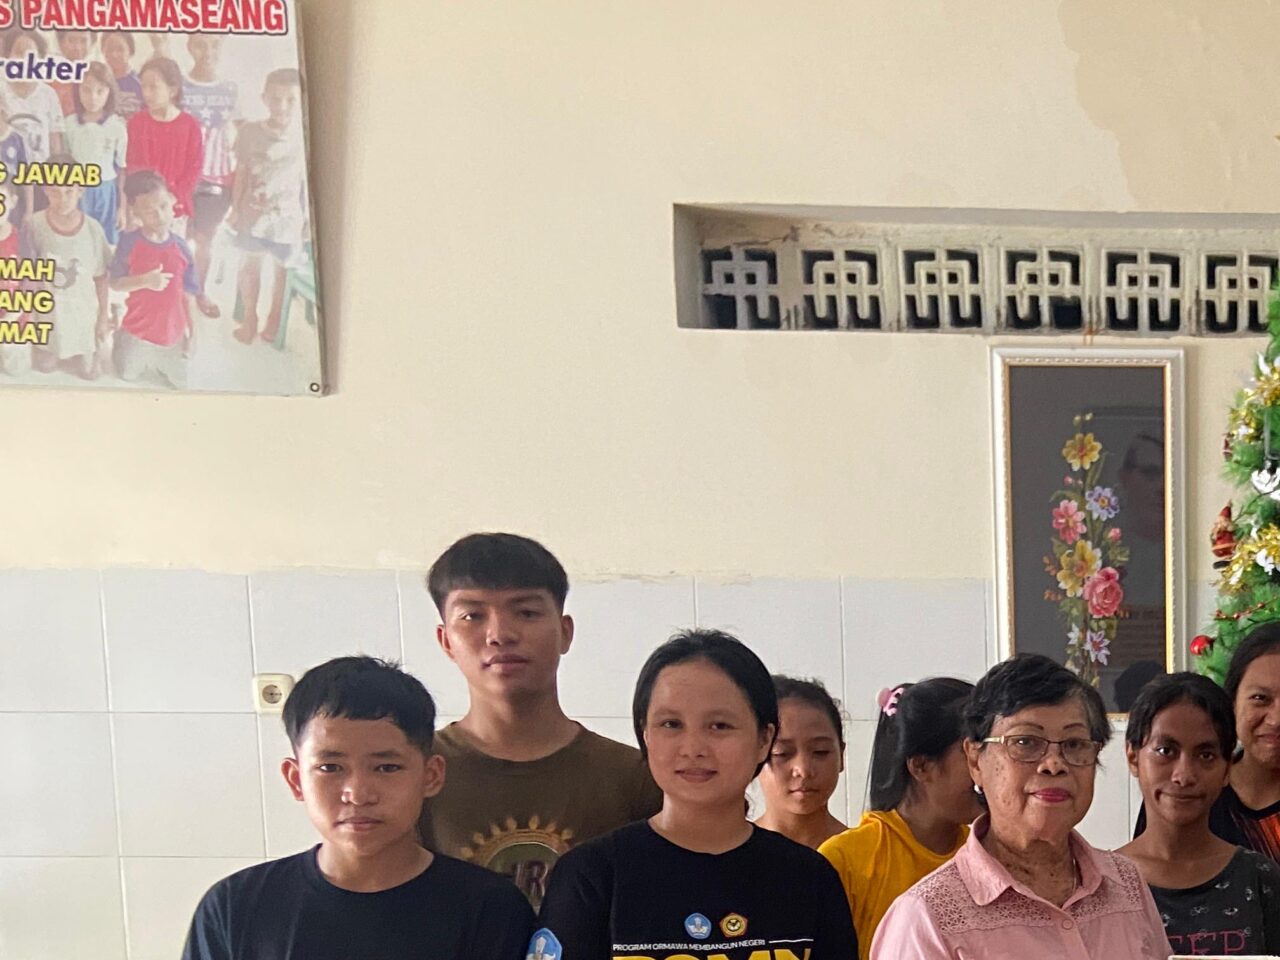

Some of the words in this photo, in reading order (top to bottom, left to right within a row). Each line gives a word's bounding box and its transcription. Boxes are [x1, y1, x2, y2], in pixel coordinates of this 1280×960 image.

[22, 0, 286, 31] PANGAMASEANG
[0, 53, 88, 80] akter
[13, 163, 101, 186] JAWAB
[612, 943, 652, 951] PROGRAM
[652, 943, 688, 951] ORMAWA
[688, 942, 738, 951] MEMBANGUN
[738, 939, 766, 948] NEGERI
